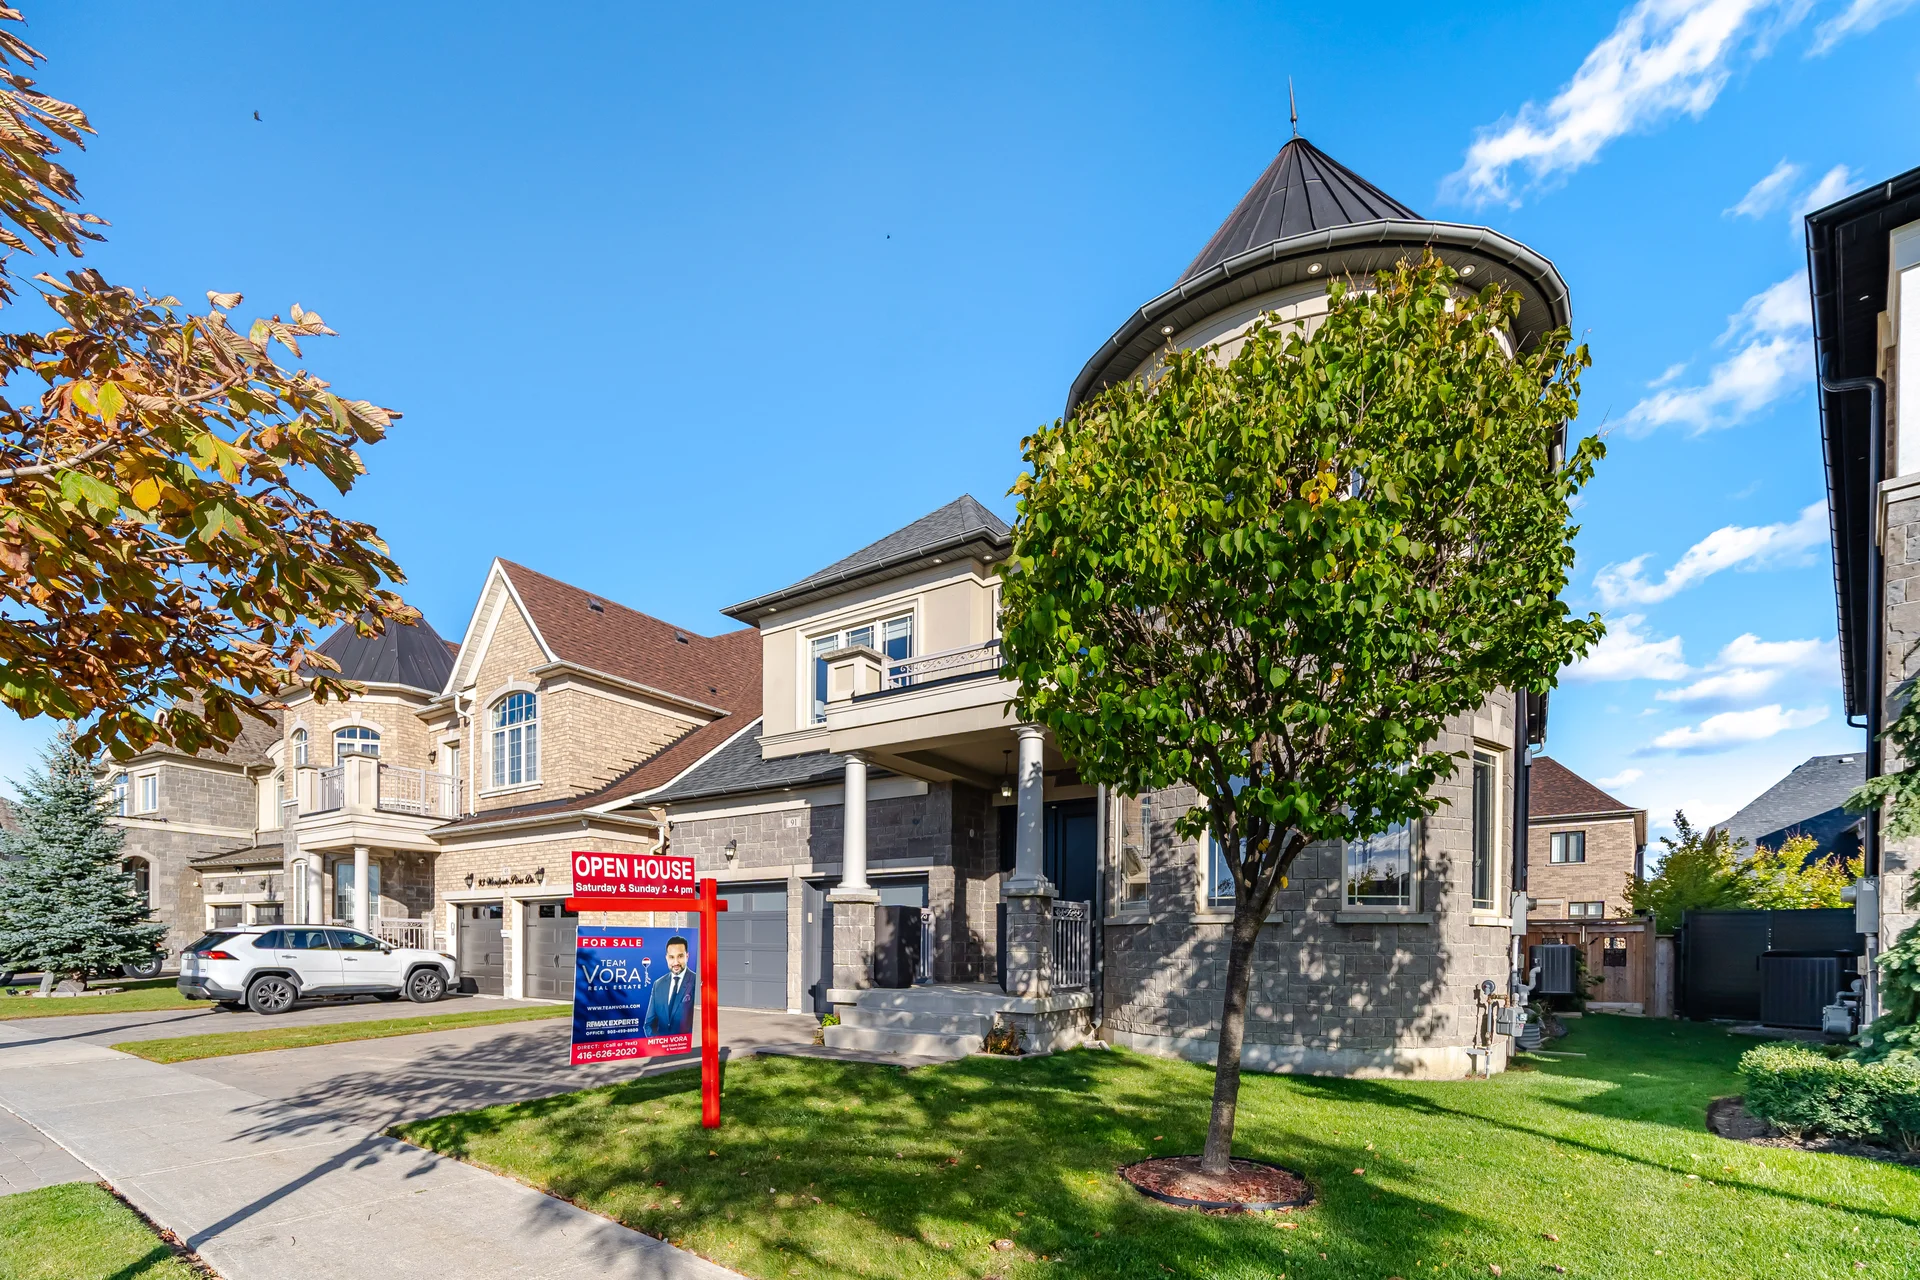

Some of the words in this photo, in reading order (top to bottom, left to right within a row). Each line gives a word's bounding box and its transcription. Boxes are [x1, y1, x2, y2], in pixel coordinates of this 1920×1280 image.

[575, 855, 629, 878] OPEN
[633, 858, 693, 880] HOUSE
[575, 882, 617, 894] Saturday
[619, 883, 627, 893] &
[628, 884, 660, 895] Sunday
[673, 886, 680, 894] 4
[680, 887, 693, 895] pm
[582, 938, 607, 947] FOR
[612, 938, 642, 947] SALE
[600, 959, 626, 967] TEAM
[582, 964, 642, 984] VORA
[586, 1003, 641, 1011] WWW.TEAMVORA.COM
[608, 1018, 639, 1026] EXPERTS
[647, 1037, 669, 1045] MITCH
[669, 1035, 688, 1043] VORA
[576, 1047, 638, 1060] 416-626-2020
